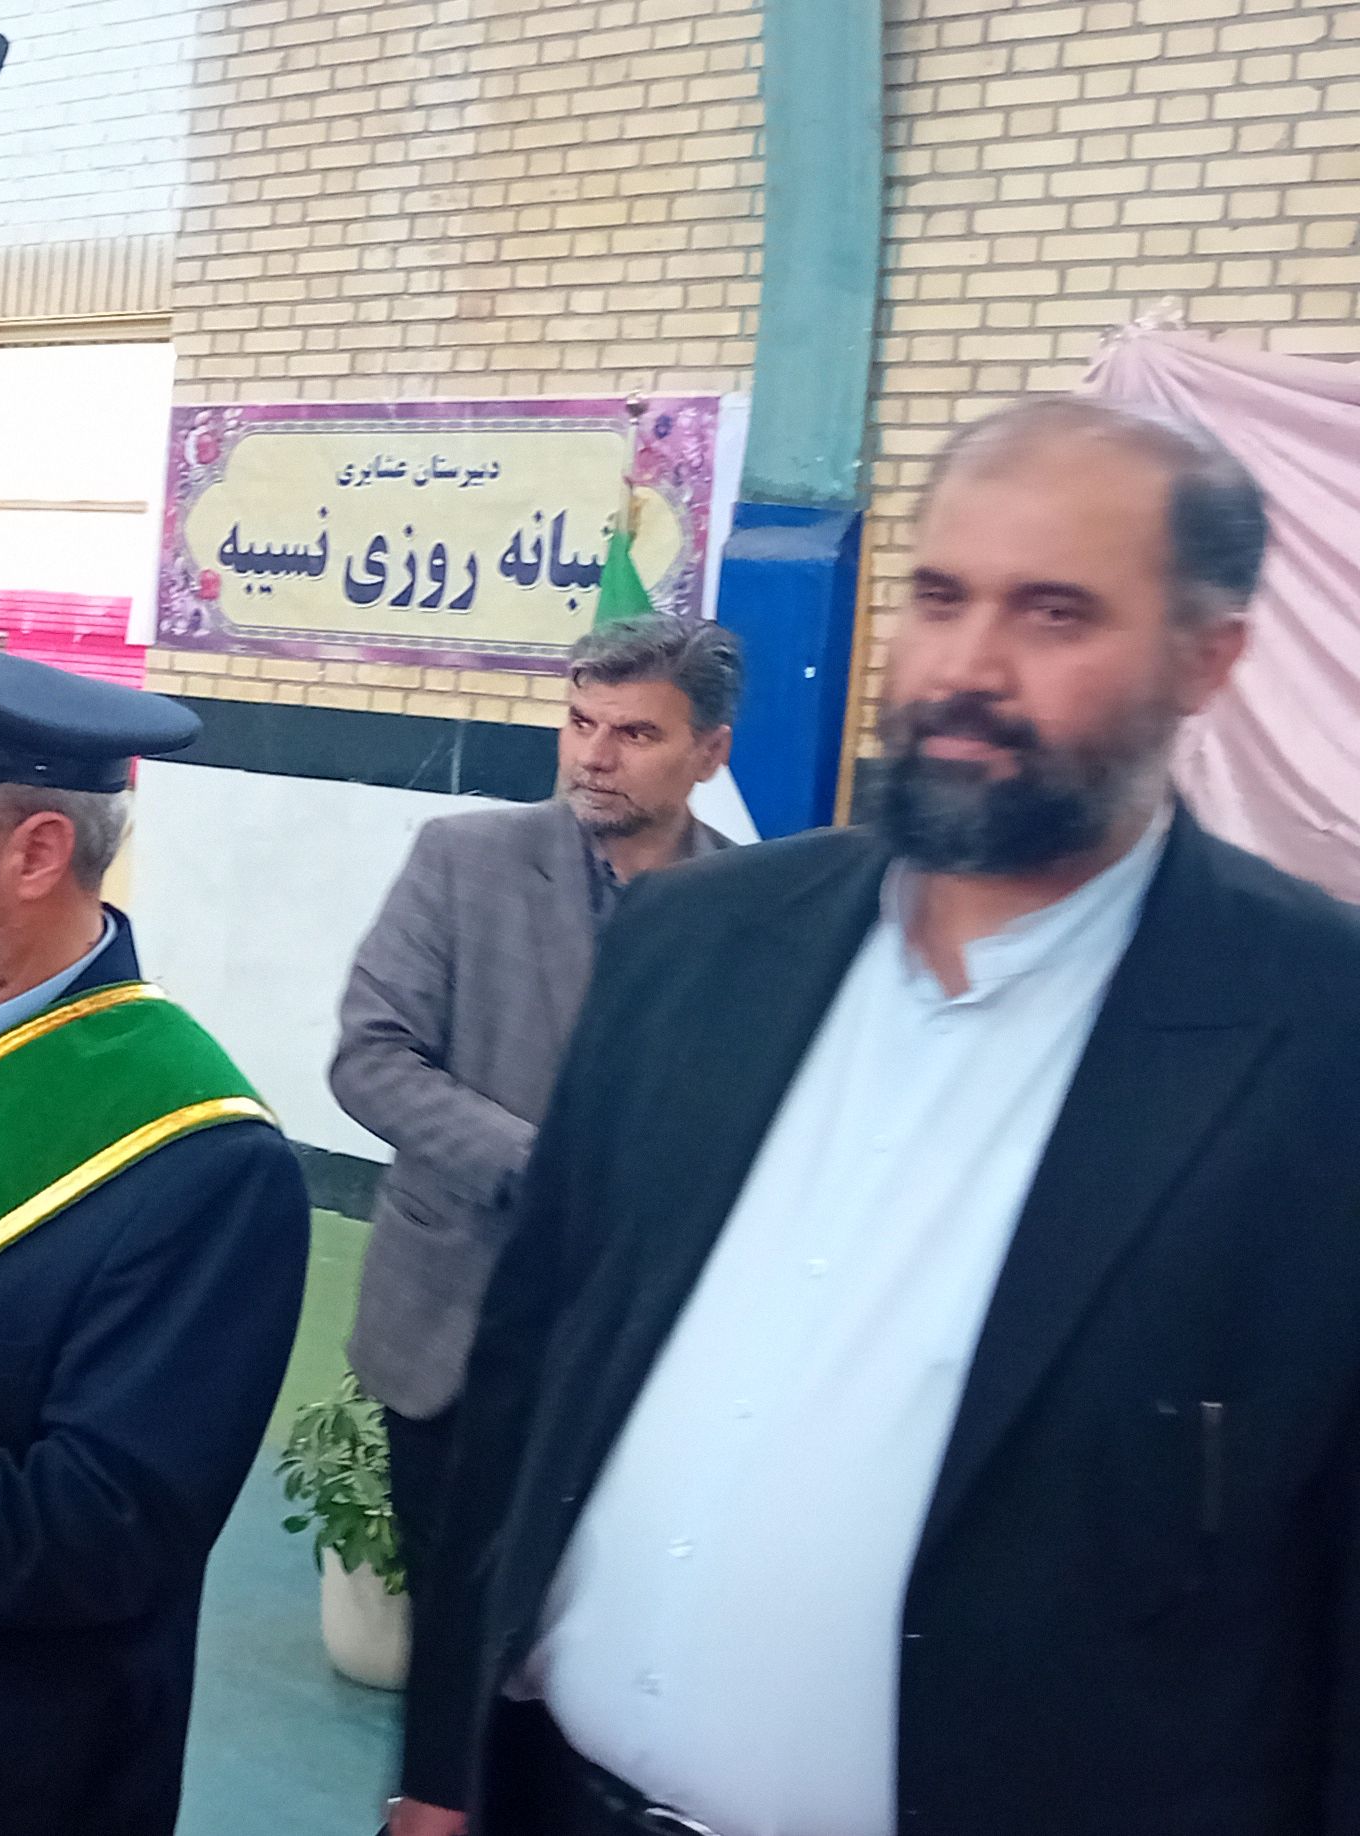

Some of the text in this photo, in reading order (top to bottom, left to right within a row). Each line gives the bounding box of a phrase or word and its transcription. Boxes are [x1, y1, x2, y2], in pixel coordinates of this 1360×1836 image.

[337, 454, 500, 487] دبیرستان عشایری
[219, 505, 330, 595] نسیبه
[346, 524, 478, 610] روزی
